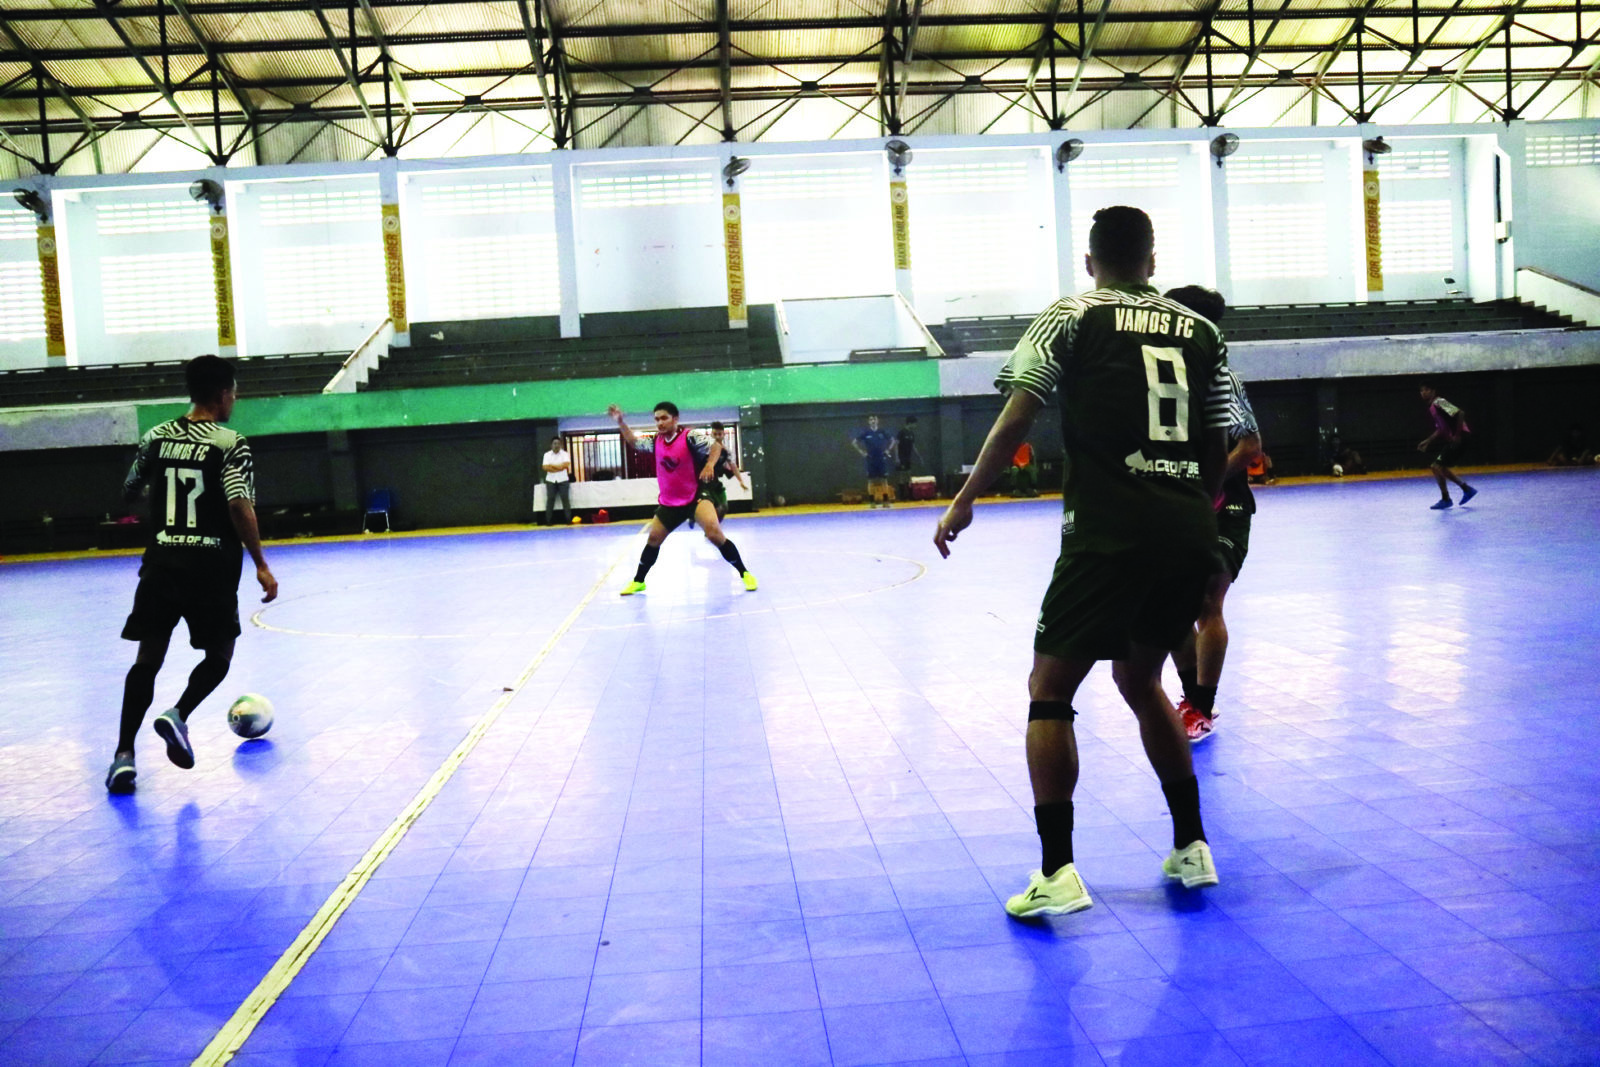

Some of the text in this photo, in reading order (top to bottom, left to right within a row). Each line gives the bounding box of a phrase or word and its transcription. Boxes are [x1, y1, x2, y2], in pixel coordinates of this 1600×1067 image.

[385, 233, 405, 319] GOR 17 DESEMBER
[726, 223, 742, 306] GOR 17 DESEMBER
[1367, 199, 1380, 279] GOR 17 DESEMBER
[42, 255, 62, 342] GOR 17 DESEMBER
[1115, 307, 1195, 338] VAMOS FC
[1141, 344, 1190, 442] 8
[158, 441, 210, 461] VAMOS FC
[164, 467, 205, 528] 17
[166, 534, 186, 543] ACE
[186, 535, 202, 544] OF
